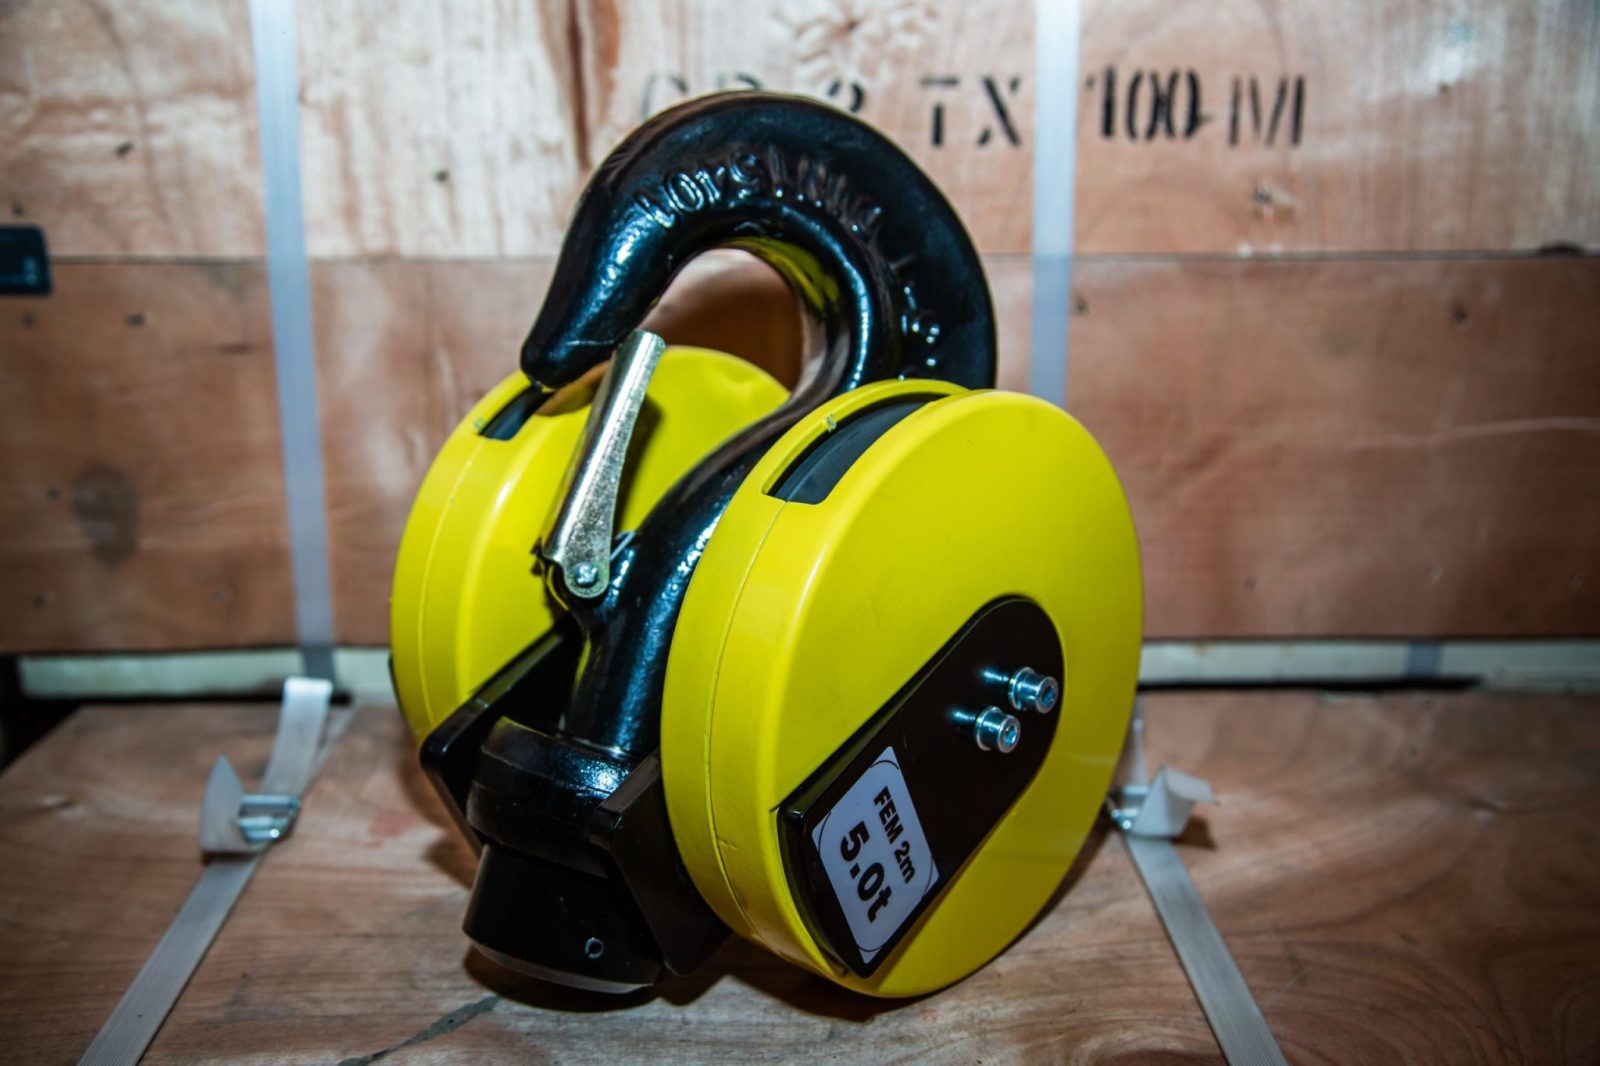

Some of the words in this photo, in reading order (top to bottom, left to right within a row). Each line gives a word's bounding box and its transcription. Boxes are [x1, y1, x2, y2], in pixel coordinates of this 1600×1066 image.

[840, 821, 892, 923] 5.0t
[874, 786, 904, 844] FEM
[894, 840, 916, 884] 2m
